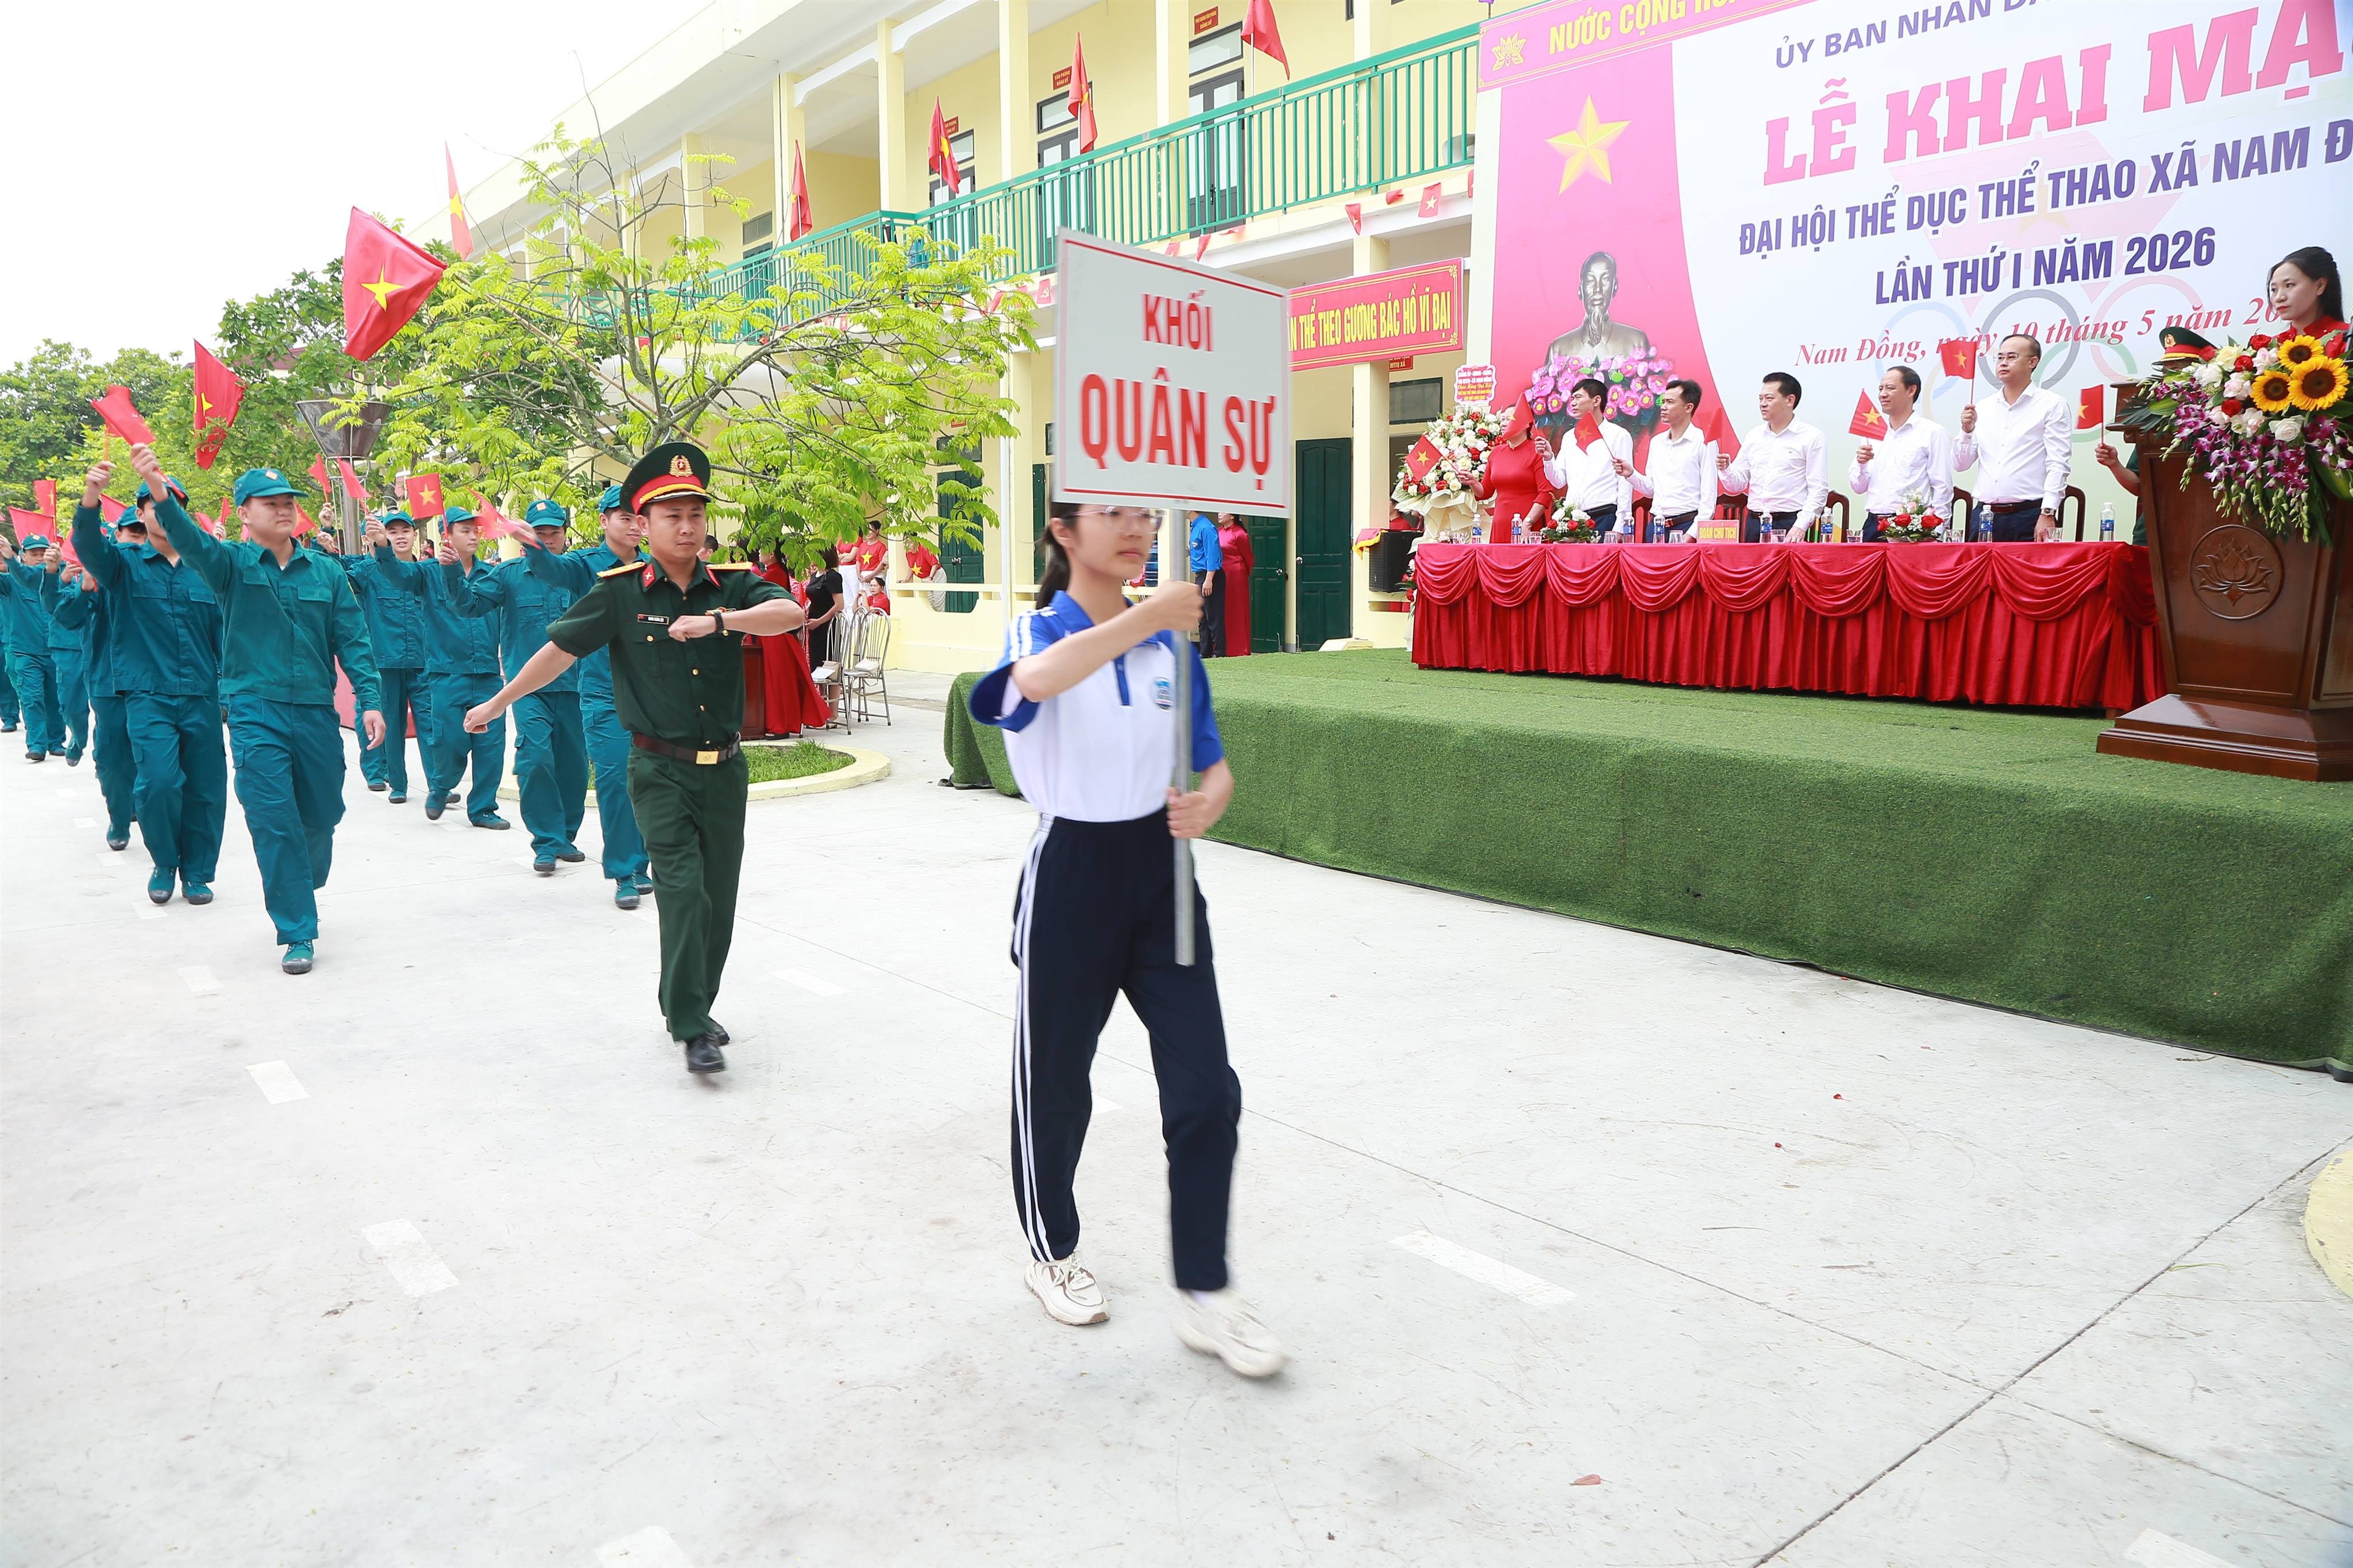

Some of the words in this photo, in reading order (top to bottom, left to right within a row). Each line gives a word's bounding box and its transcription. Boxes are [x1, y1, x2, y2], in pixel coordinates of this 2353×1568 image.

[1549, 6, 1612, 55] NƯỚC
[1776, 35, 1815, 68] ỦY
[1824, 20, 1887, 57] BAN
[1764, 77, 1857, 186] LỄ
[1884, 43, 2112, 164] KHAI
[1739, 218, 1781, 260] ĐẠI
[1791, 204, 1835, 252] HỘI
[1846, 184, 1900, 239] THỂ
[1907, 187, 1967, 235] DỤC
[1978, 160, 2040, 220] THỂ
[2049, 160, 2136, 208] THAO
[2149, 141, 2198, 193] XÃ
[2213, 126, 2310, 183] NAM
[1876, 256, 1932, 305] LẦN
[1943, 244, 2007, 293] THỨ
[2013, 251, 2022, 289] I
[2034, 236, 2112, 286] NĂM
[2125, 227, 2216, 276] 2026
[1141, 289, 1213, 352] KHỐI
[1299, 298, 1317, 350] THỂ
[1318, 308, 1343, 347] THEO
[1344, 302, 1378, 344] GƯƠNG
[1379, 292, 1401, 338] BÁC
[1403, 283, 1417, 335] HỒ
[1419, 286, 1430, 333] VĨ
[1432, 291, 1451, 339] ĐẠI
[1794, 343, 1847, 366] Nam
[1856, 329, 1926, 363] Đồng,
[2045, 316, 2128, 345] tháng
[2137, 309, 2155, 335] 5
[2165, 304, 2232, 330] năm
[1080, 366, 1209, 470] QUÂN
[1222, 395, 1278, 491] SỰ
[1699, 525, 1713, 539] ĐOÀN
[1714, 522, 1724, 539] CHỦ
[1725, 527, 1736, 541] TỊCH
